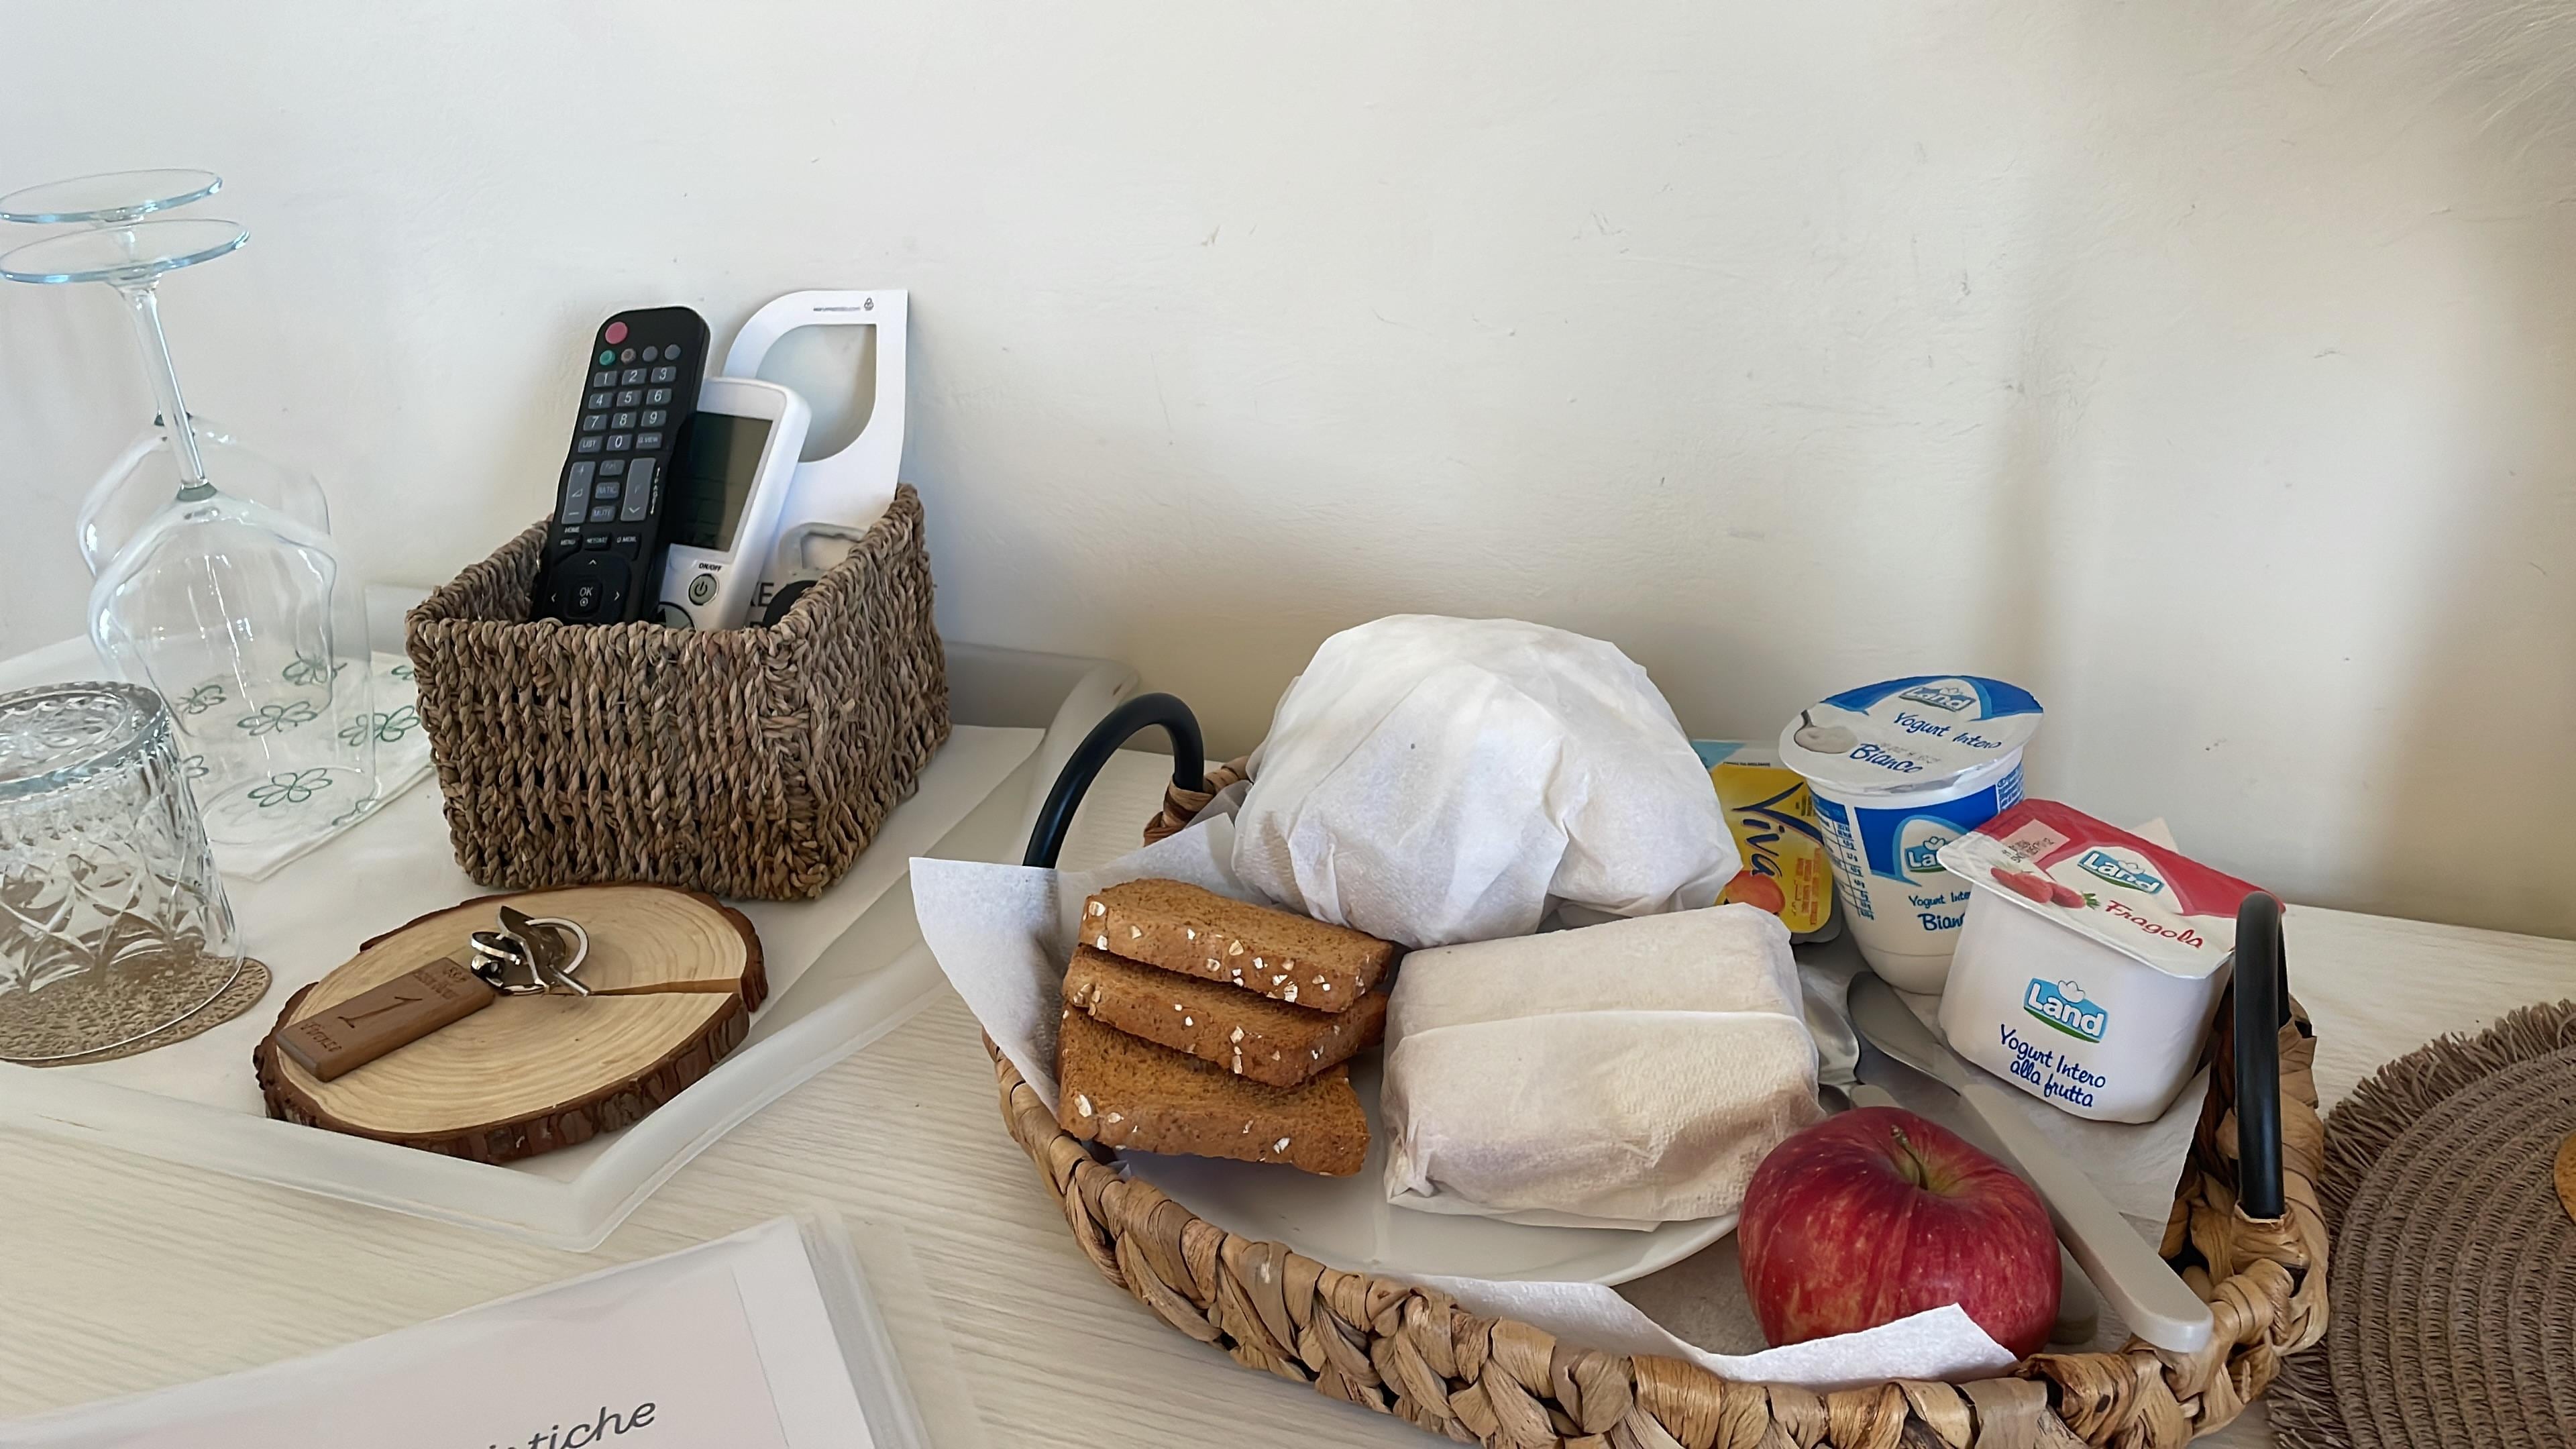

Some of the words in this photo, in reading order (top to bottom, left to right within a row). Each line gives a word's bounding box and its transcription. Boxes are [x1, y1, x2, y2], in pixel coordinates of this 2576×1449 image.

[629, 370, 638, 382] 2
[659, 368, 667, 380] 3
[596, 394, 604, 406] 4
[625, 391, 633, 403] 5
[654, 390, 663, 402] 6
[591, 416, 599, 429] 7
[619, 413, 628, 427] 8
[649, 411, 657, 424] 9
[582, 439, 596, 448] LIST
[614, 435, 623, 448] 0
[698, 562, 722, 572] ON/OFF
[579, 586, 594, 597] OK
[1909, 688, 1971, 708] Land
[1894, 712, 1951, 737] Yogurt
[1952, 732, 2002, 749] Intero
[1731, 781, 1825, 879] Viva
[1908, 851, 1937, 867] La
[2084, 853, 2160, 892] Land
[1909, 895, 1945, 908] Yogurt
[1917, 912, 1966, 931] Bian
[2105, 900, 2203, 949] Fragola
[337, 996, 423, 1028] 1
[2028, 983, 2104, 1036] Land
[2000, 1024, 2053, 1067] Yogurt
[2056, 1055, 2106, 1088] Intero
[2010, 1059, 2041, 1085] alla
[2043, 1073, 2094, 1108] frutta
